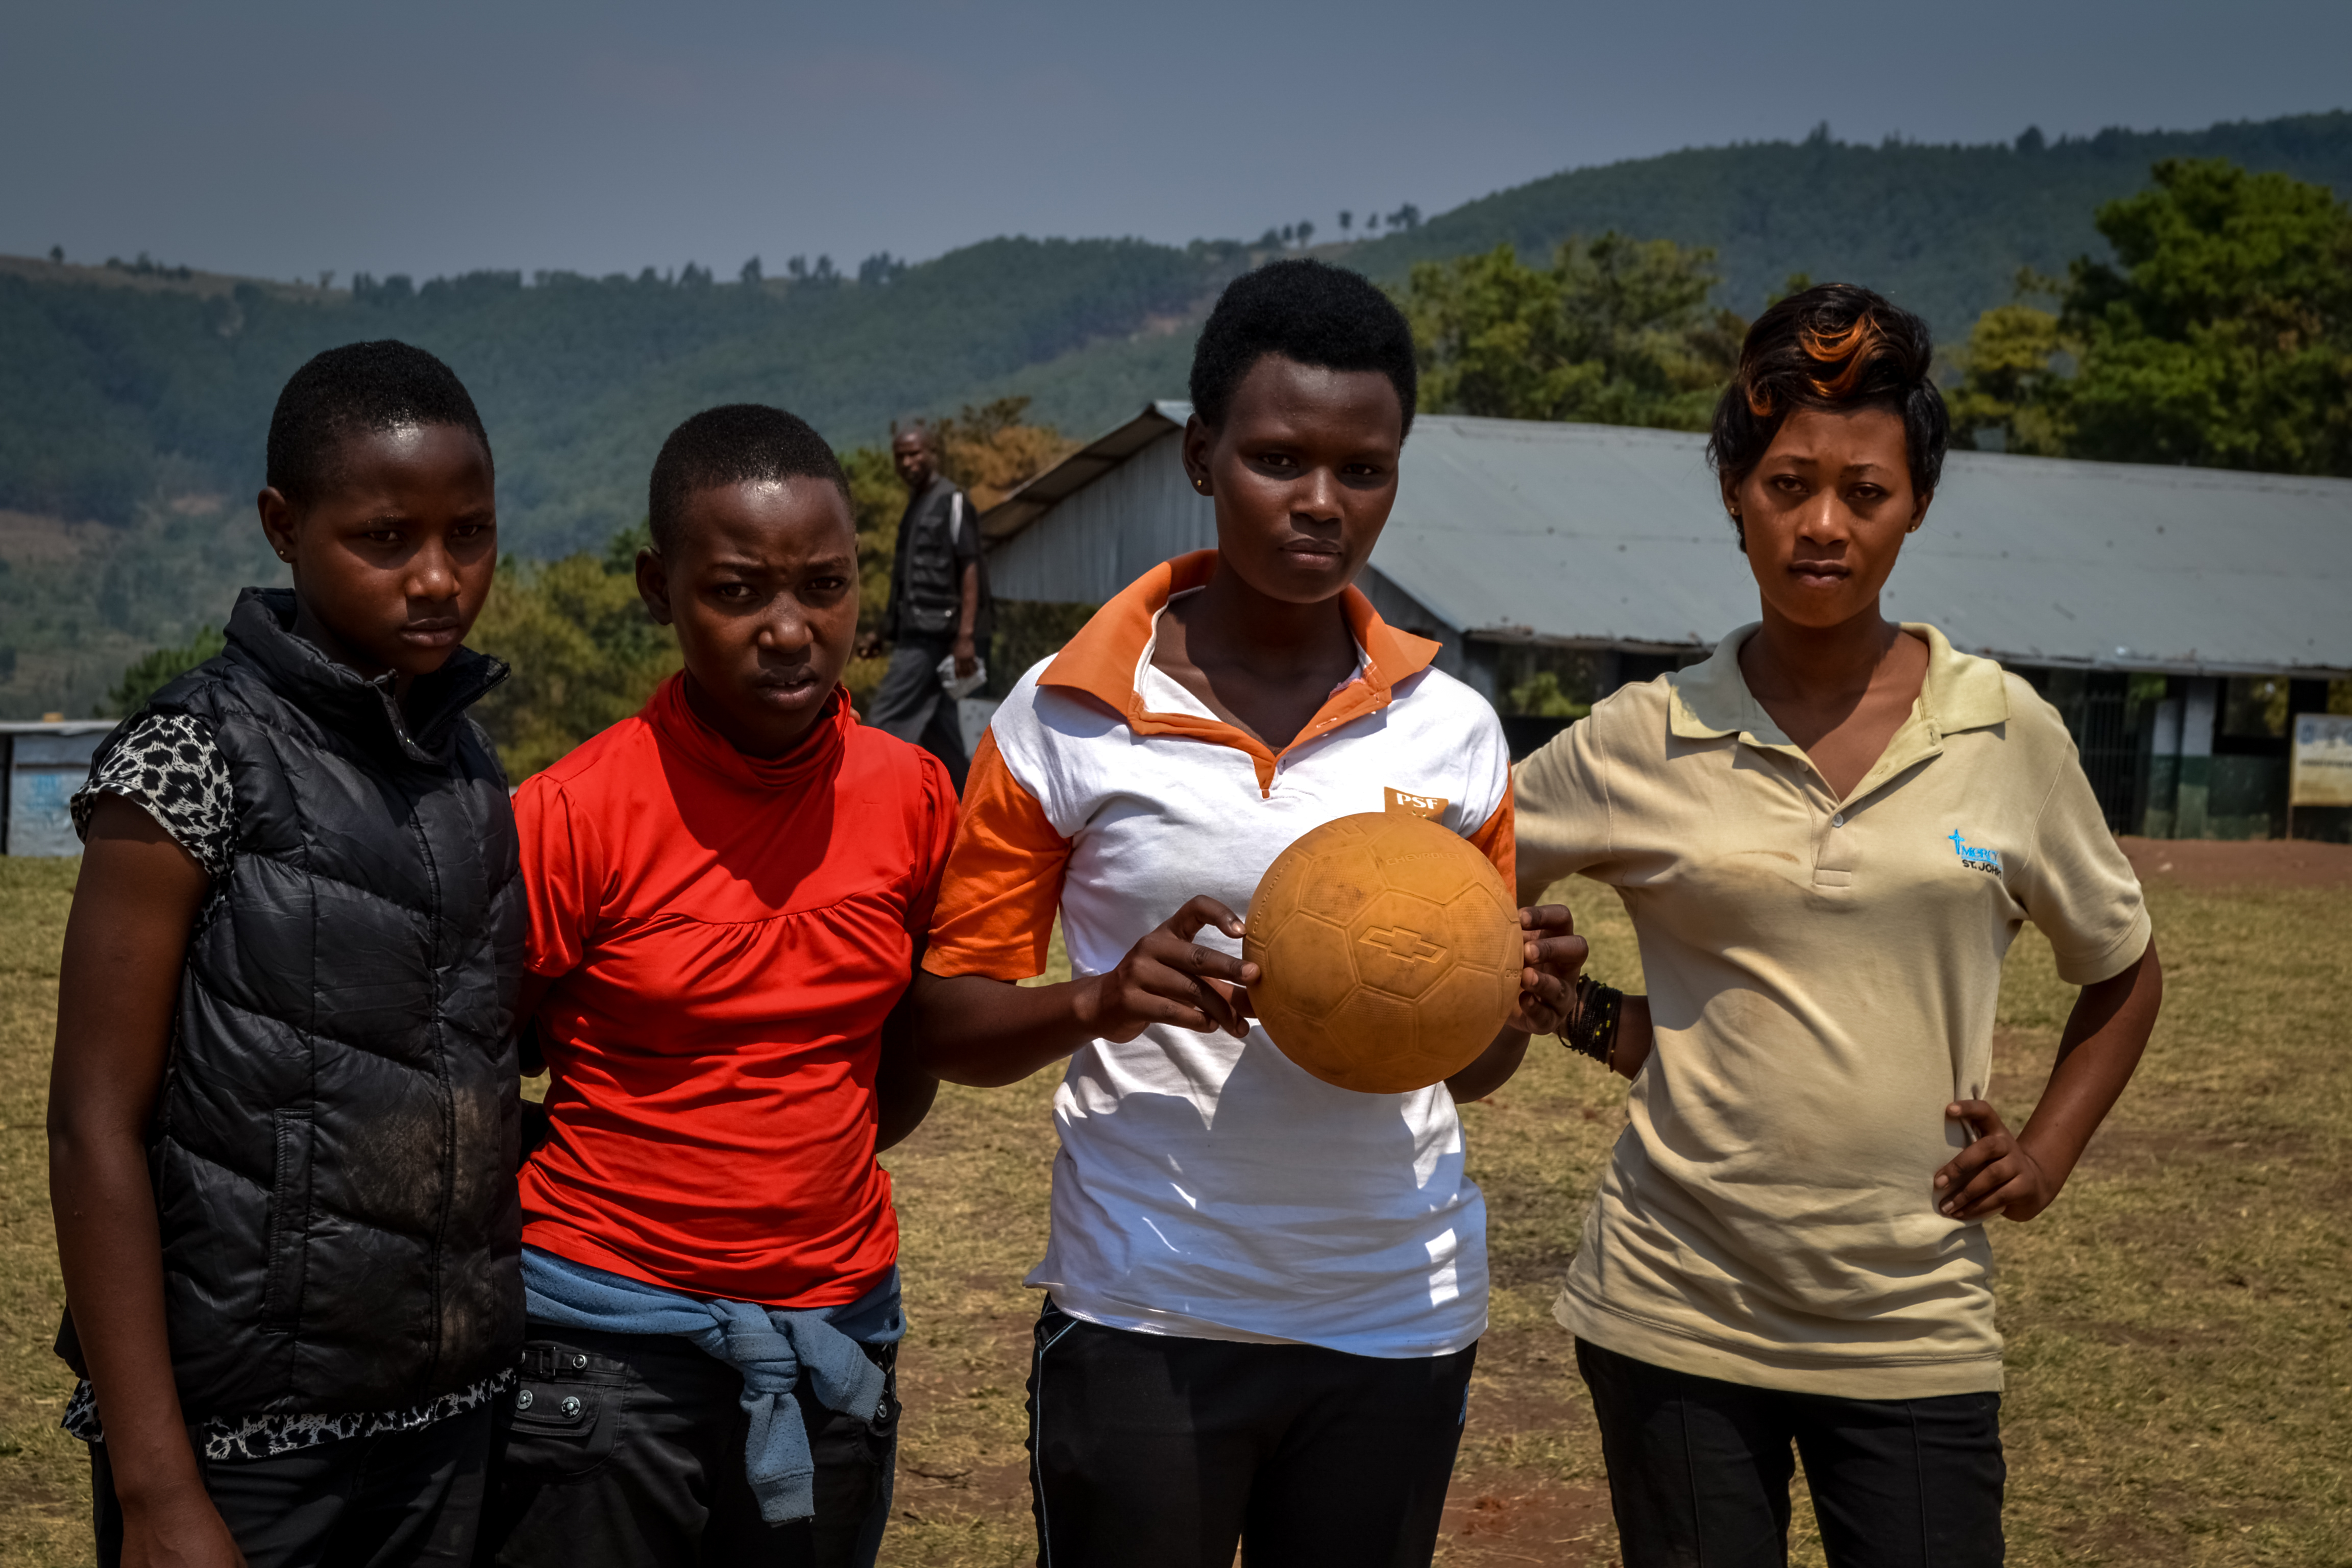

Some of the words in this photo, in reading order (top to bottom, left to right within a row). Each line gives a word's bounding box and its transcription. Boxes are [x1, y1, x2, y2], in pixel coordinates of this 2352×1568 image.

[1396, 793, 1438, 809] PSF
[1386, 852, 1460, 865] CHEVROLET
[1961, 845, 1999, 861] MERCY
[1962, 859, 1977, 869] ST.
